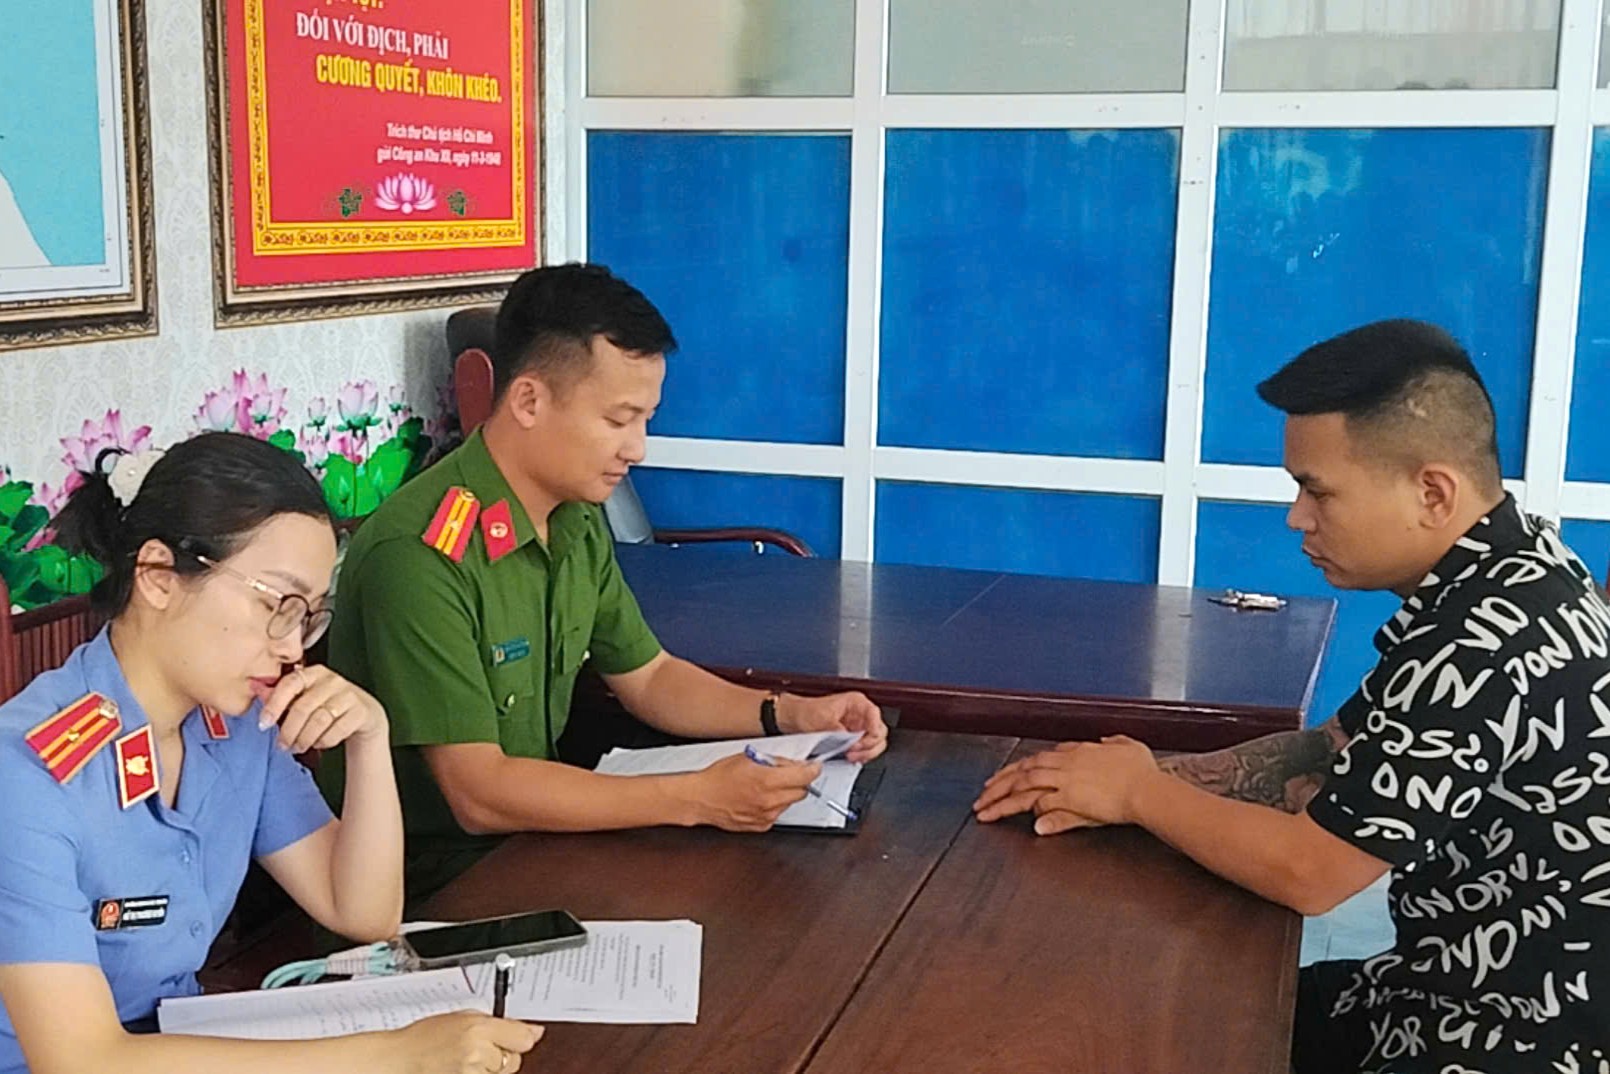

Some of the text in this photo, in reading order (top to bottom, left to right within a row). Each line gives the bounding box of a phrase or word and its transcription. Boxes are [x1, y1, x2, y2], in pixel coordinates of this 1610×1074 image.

[332, 15, 364, 47] VỚI
[367, 25, 411, 57] ĐỊCH,
[413, 31, 448, 60] PHẢI
[316, 54, 372, 88] CƯƠNG
